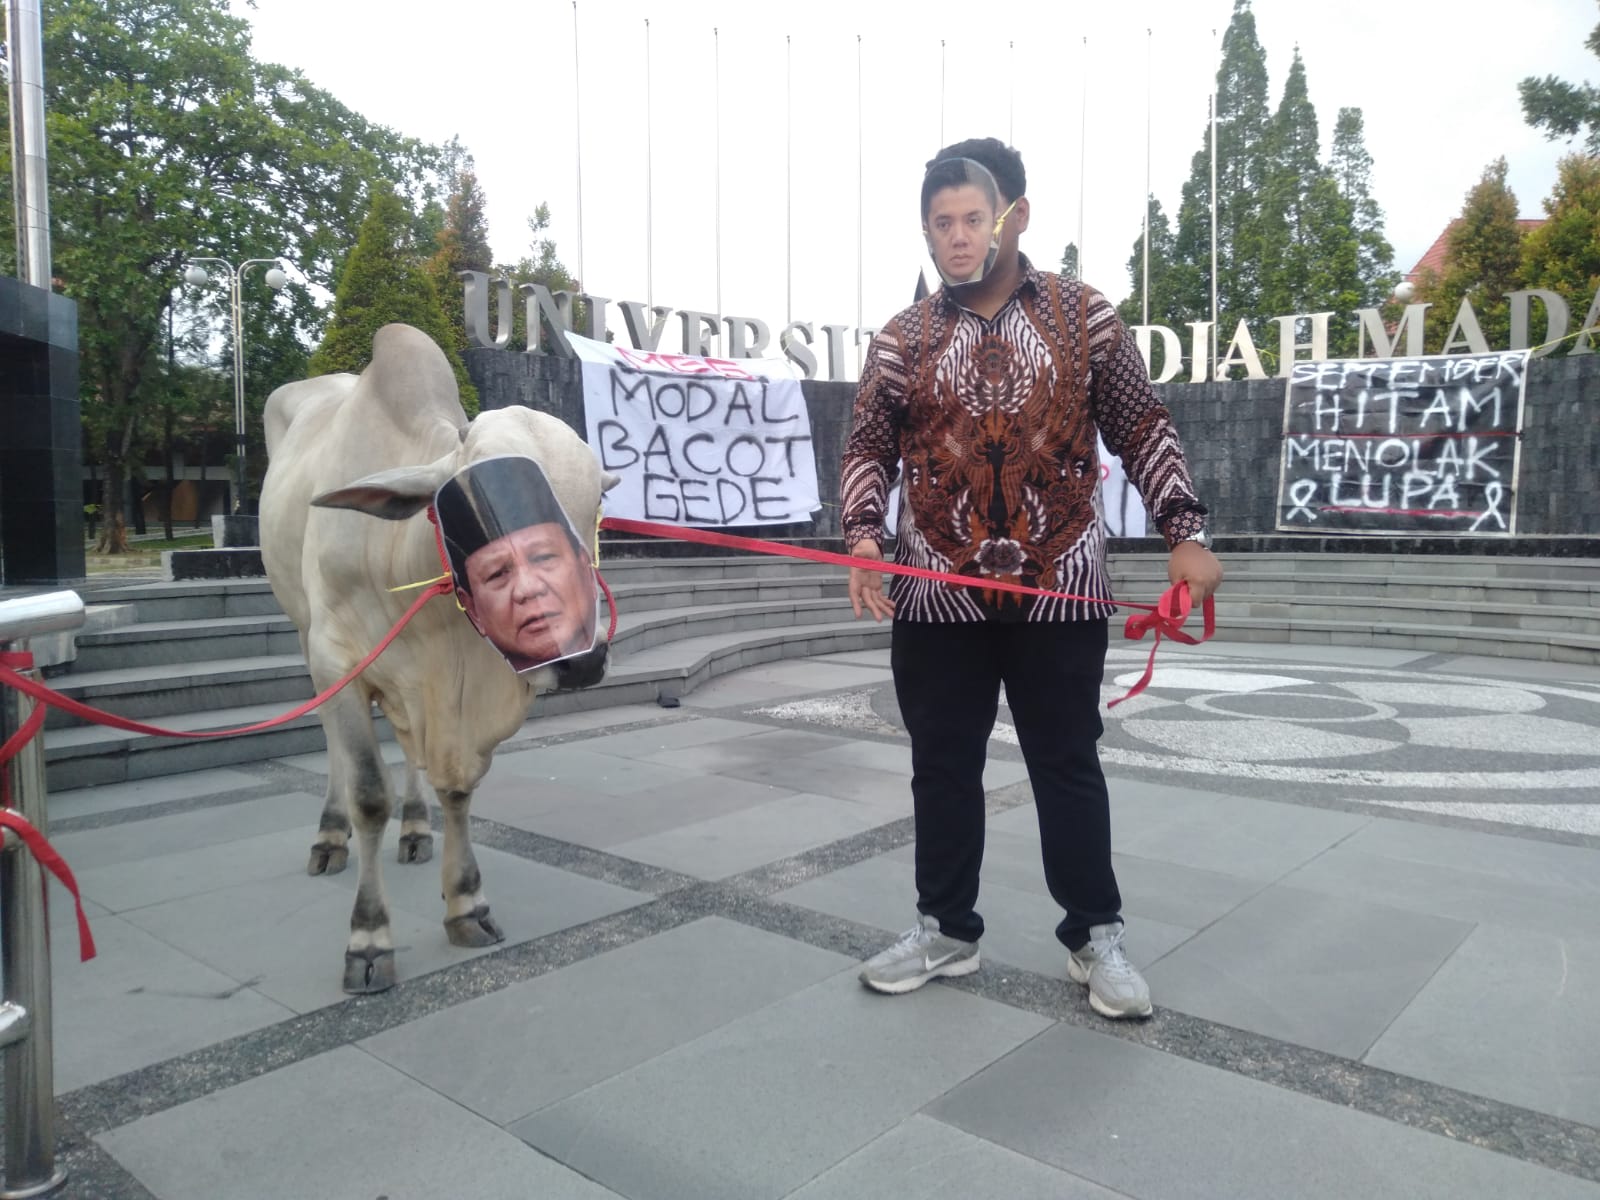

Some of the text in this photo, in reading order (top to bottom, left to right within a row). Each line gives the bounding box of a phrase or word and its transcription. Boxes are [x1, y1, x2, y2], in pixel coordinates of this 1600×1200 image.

[1291, 353, 1522, 391] SEPTEMBER
[609, 368, 799, 426] MODAL
[1315, 387, 1501, 434] HITAM
[597, 419, 811, 478] BACOT
[1286, 435, 1501, 480] MENOLAK
[643, 473, 791, 525] GEDE
[1330, 472, 1460, 510] LUPA
